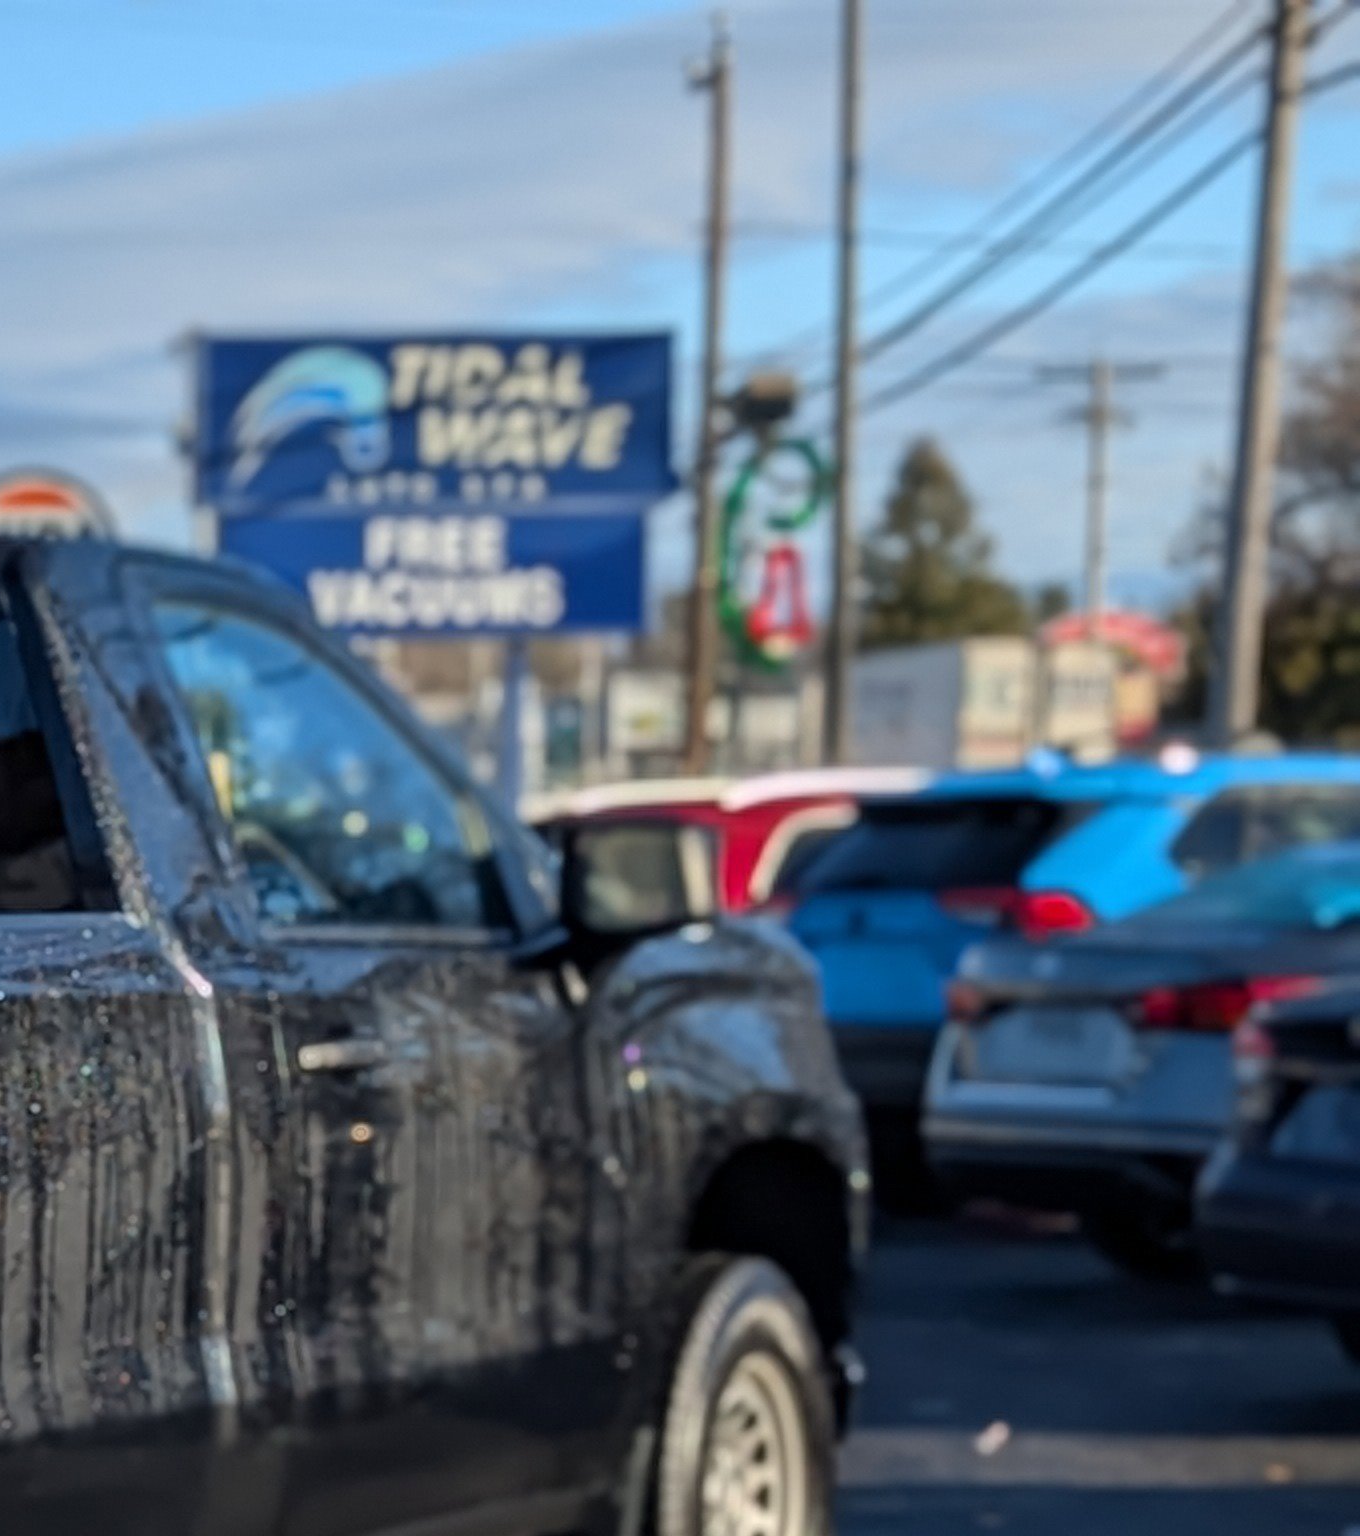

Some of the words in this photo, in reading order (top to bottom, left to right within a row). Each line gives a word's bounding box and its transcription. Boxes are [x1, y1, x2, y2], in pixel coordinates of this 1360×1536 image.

[389, 343, 591, 410] TIDAL
[417, 401, 633, 471] WAVE
[363, 514, 506, 571] FREE
[306, 566, 565, 628] VACUUMS
